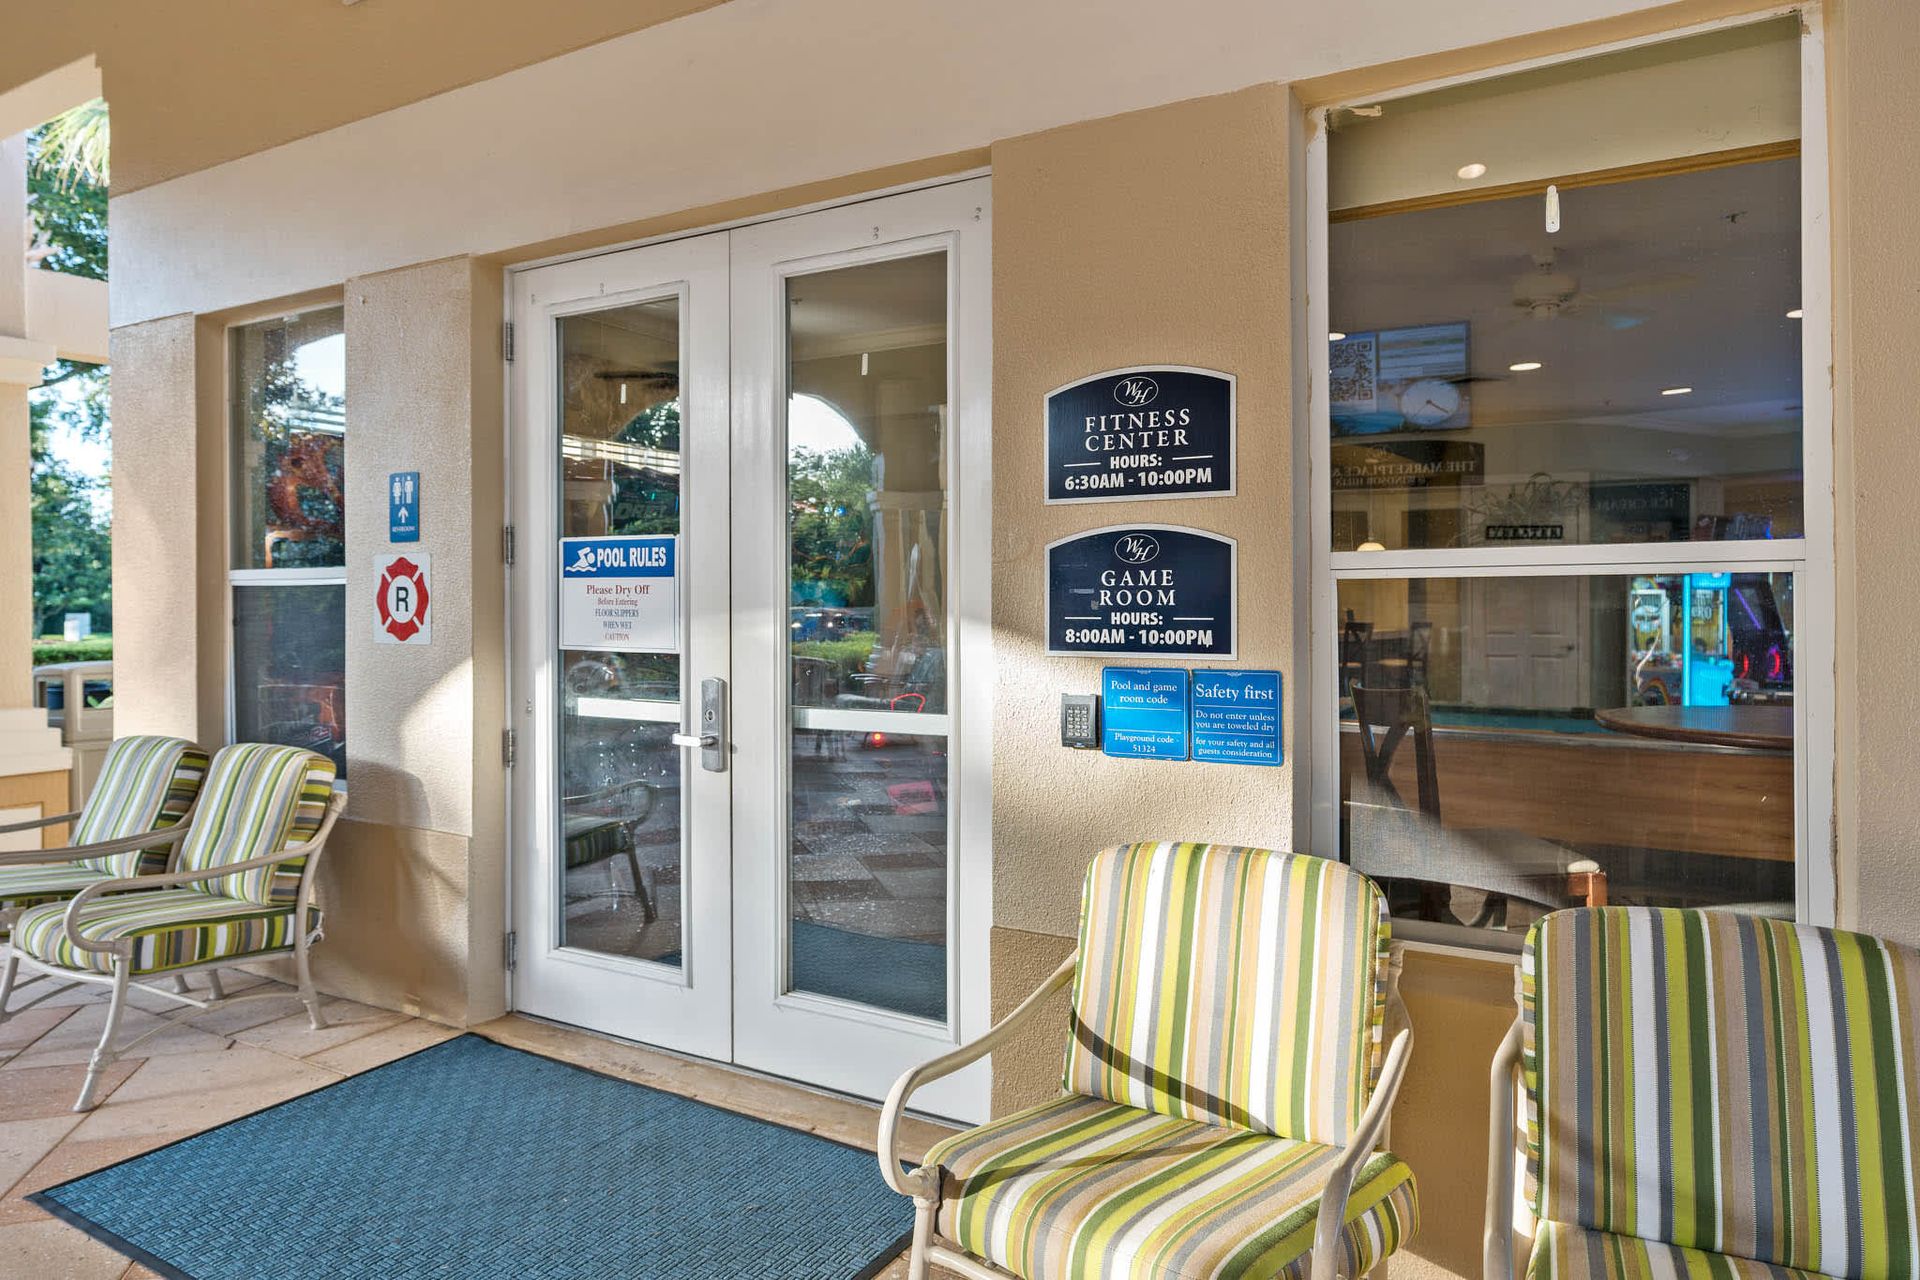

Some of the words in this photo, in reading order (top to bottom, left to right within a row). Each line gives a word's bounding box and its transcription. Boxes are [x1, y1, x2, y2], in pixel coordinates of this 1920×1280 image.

[1085, 408, 1191, 433] FITNESS
[1085, 429, 1189, 451] CENTER
[1110, 453, 1163, 469] HOURS:
[1065, 472, 1125, 490] 6:30AM
[1138, 467, 1213, 487] 10:00PM
[597, 547, 626, 568] POOL
[630, 546, 666, 568] RULES
[1101, 569, 1174, 587] GAME
[396, 586, 409, 612] R
[587, 584, 613, 595] Please
[616, 584, 631, 598] Dry
[635, 584, 650, 595] Off
[1100, 589, 1176, 606] ROOM
[1111, 612, 1163, 625] HOURS:
[1065, 628, 1125, 644] 8:00AM
[1138, 629, 1213, 646] 10:00PM
[1111, 680, 1131, 690] Pool
[1133, 681, 1151, 691] and
[1153, 684, 1178, 693] game
[1195, 683, 1240, 701] Safety
[1244, 684, 1274, 700] first
[1120, 695, 1144, 703] room
[1146, 694, 1168, 704] code
[1195, 709, 1208, 718] Do
[1210, 711, 1223, 719] not
[1225, 712, 1247, 720] enter
[1249, 712, 1275, 721] unless
[1195, 721, 1210, 730] you
[1227, 721, 1259, 731] toweled
[1261, 722, 1275, 733] dry
[1114, 732, 1155, 743] Playground
[1156, 735, 1175, 744] code
[1195, 736, 1206, 745] for
[1208, 738, 1225, 747] your
[1226, 739, 1248, 749] safety
[1249, 740, 1264, 748] and
[1265, 740, 1275, 749] all
[1198, 747, 1220, 756] guests
[1222, 749, 1273, 759] consideration
